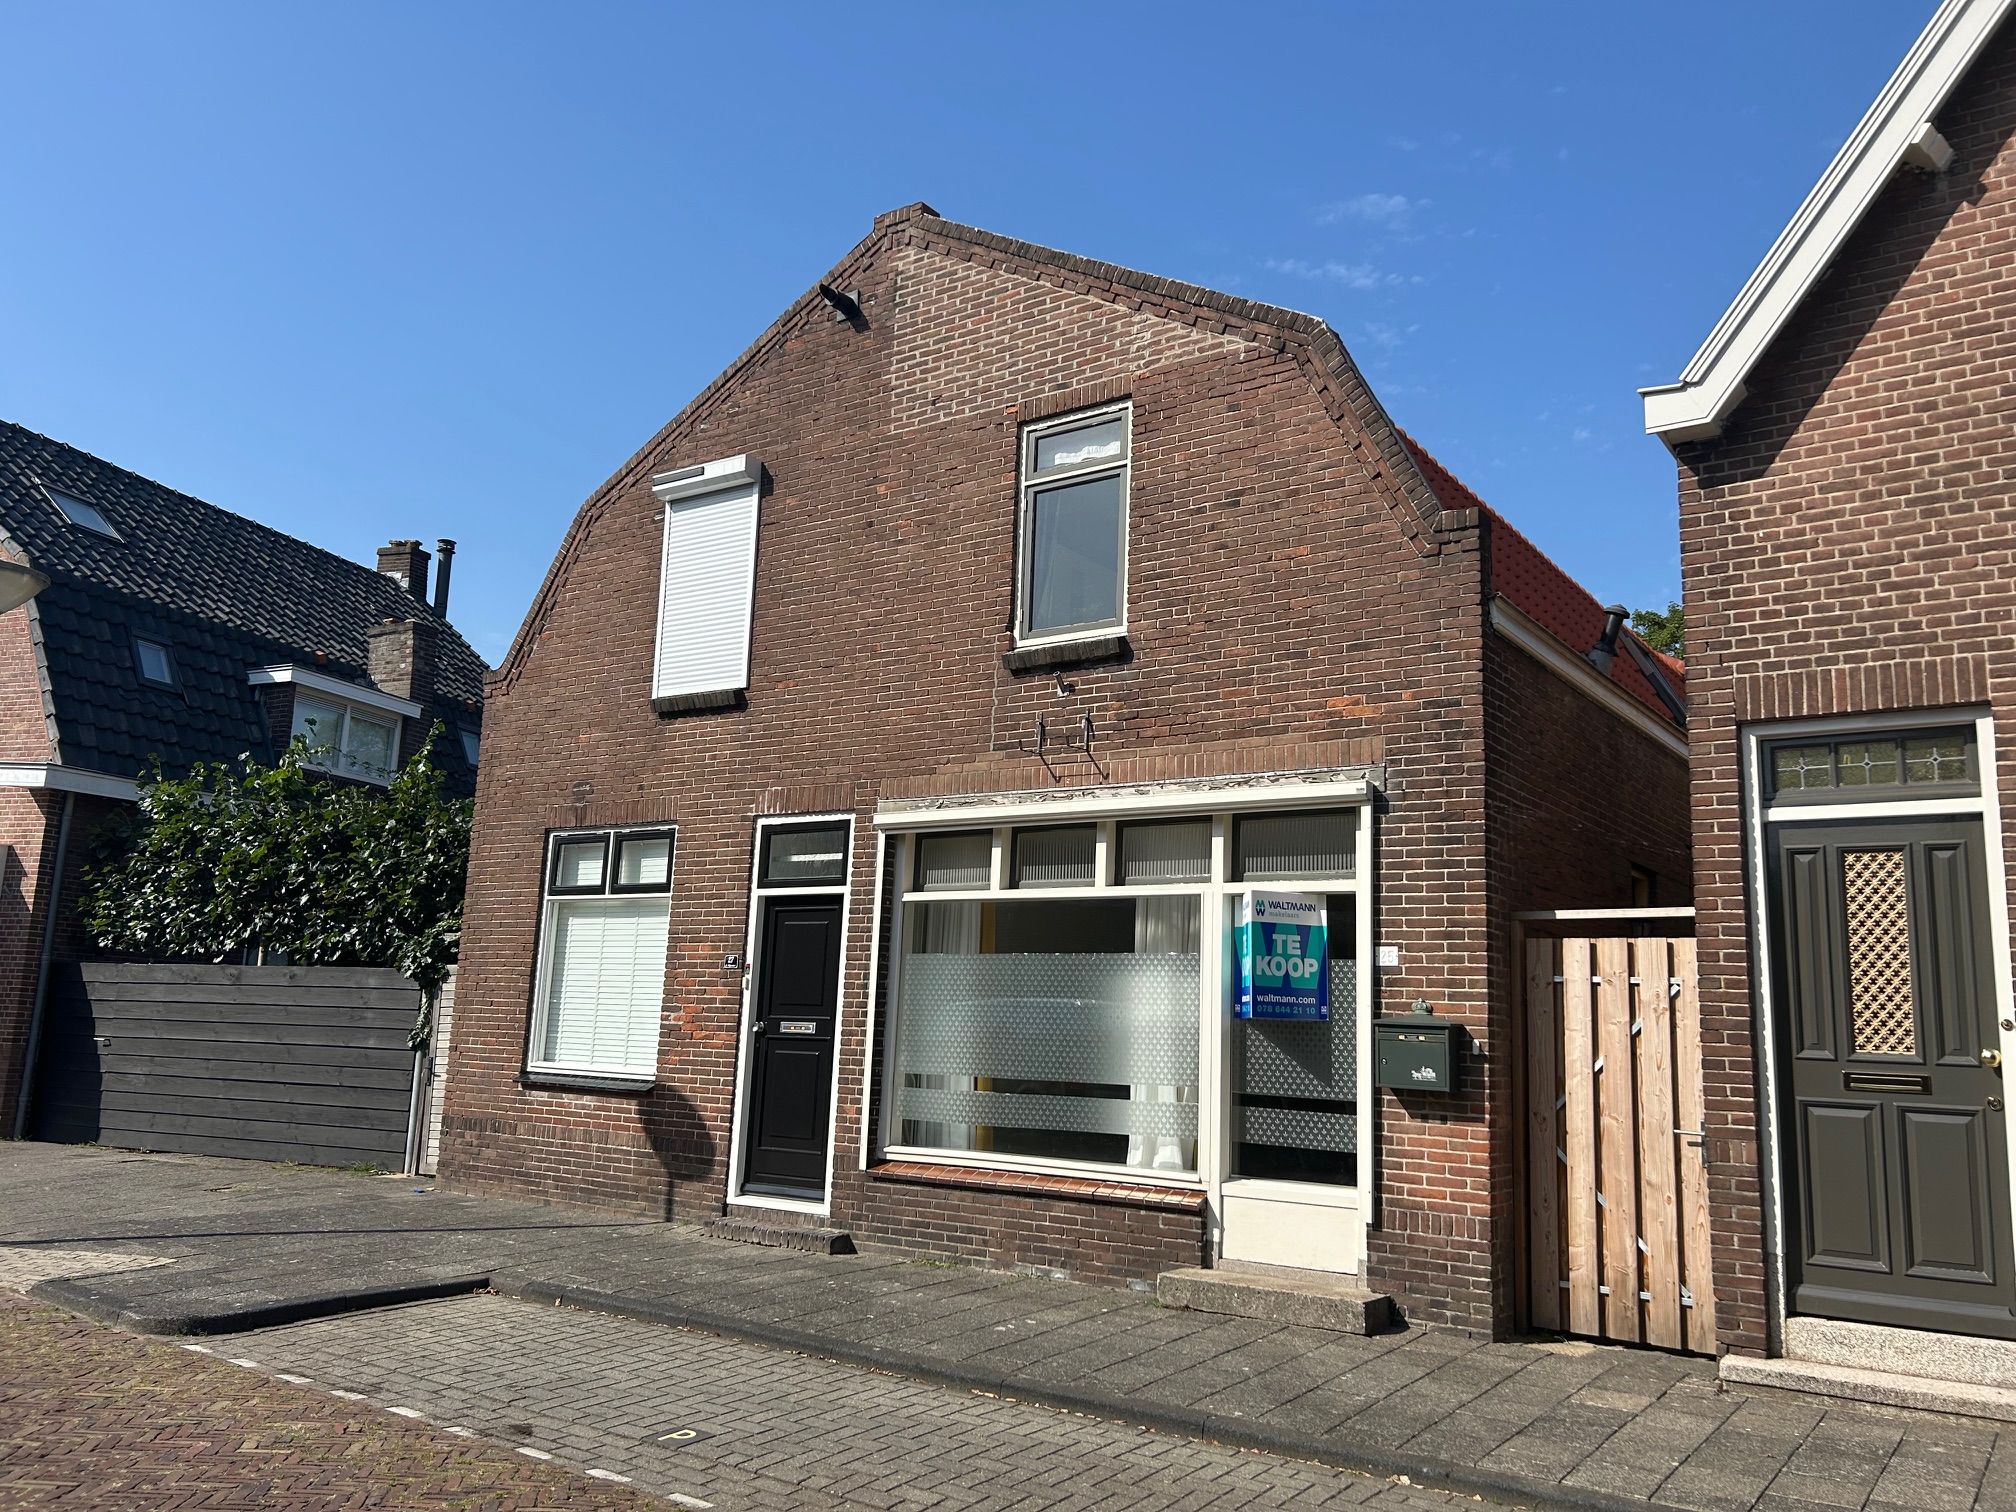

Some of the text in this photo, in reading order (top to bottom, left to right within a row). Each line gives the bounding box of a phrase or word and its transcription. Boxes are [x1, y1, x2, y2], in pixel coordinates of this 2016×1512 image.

[1268, 900, 1316, 912] WALTMANN
[1272, 933, 1301, 955] TE
[1381, 950, 1394, 963] 25
[1256, 955, 1318, 978] KOOP
[1257, 993, 1316, 1004] waltmann.com
[1257, 1004, 1273, 1013] 078
[1293, 1006, 1302, 1014] 21
[1305, 1006, 1316, 1014] 10
[658, 1429, 697, 1441] P
